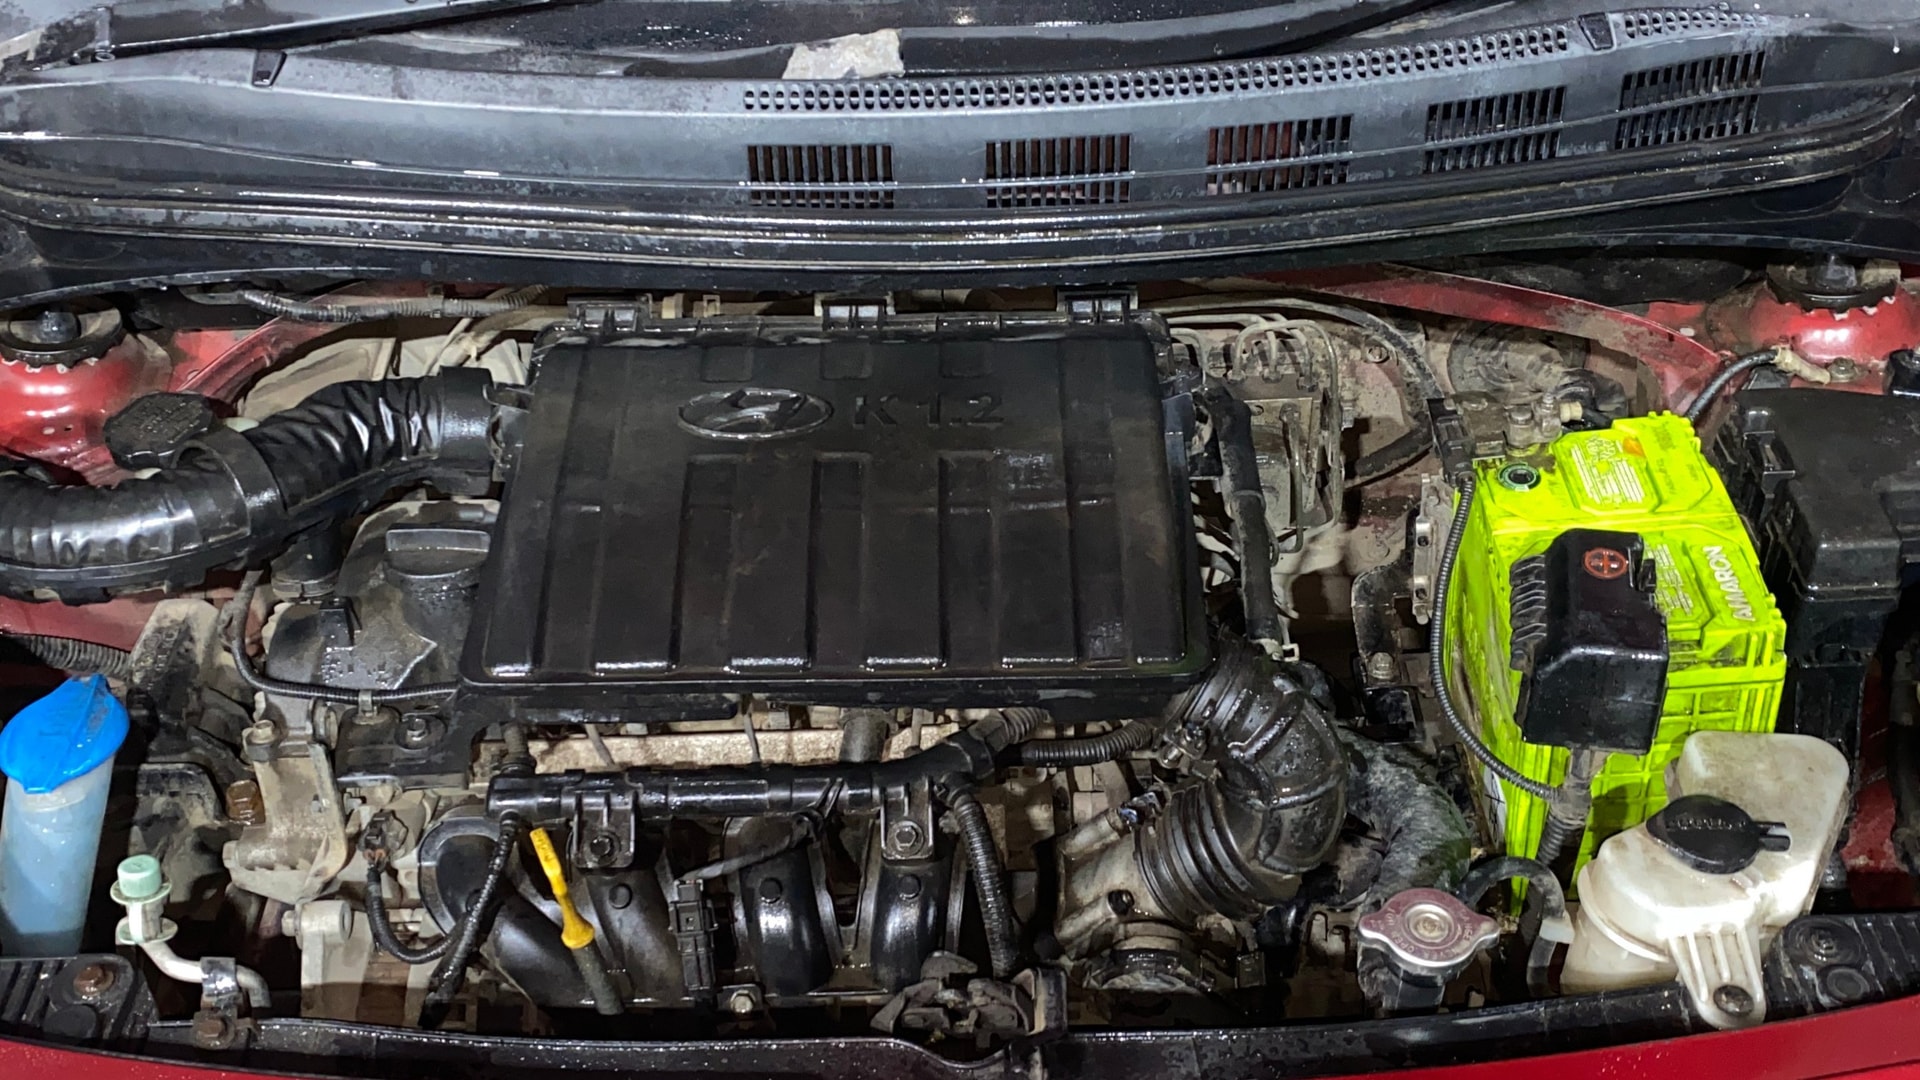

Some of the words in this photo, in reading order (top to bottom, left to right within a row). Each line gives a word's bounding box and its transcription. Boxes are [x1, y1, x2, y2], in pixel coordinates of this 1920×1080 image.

[853, 394, 897, 428] K
[917, 393, 1004, 428] 1.2
[1703, 546, 1755, 621] AMARON
